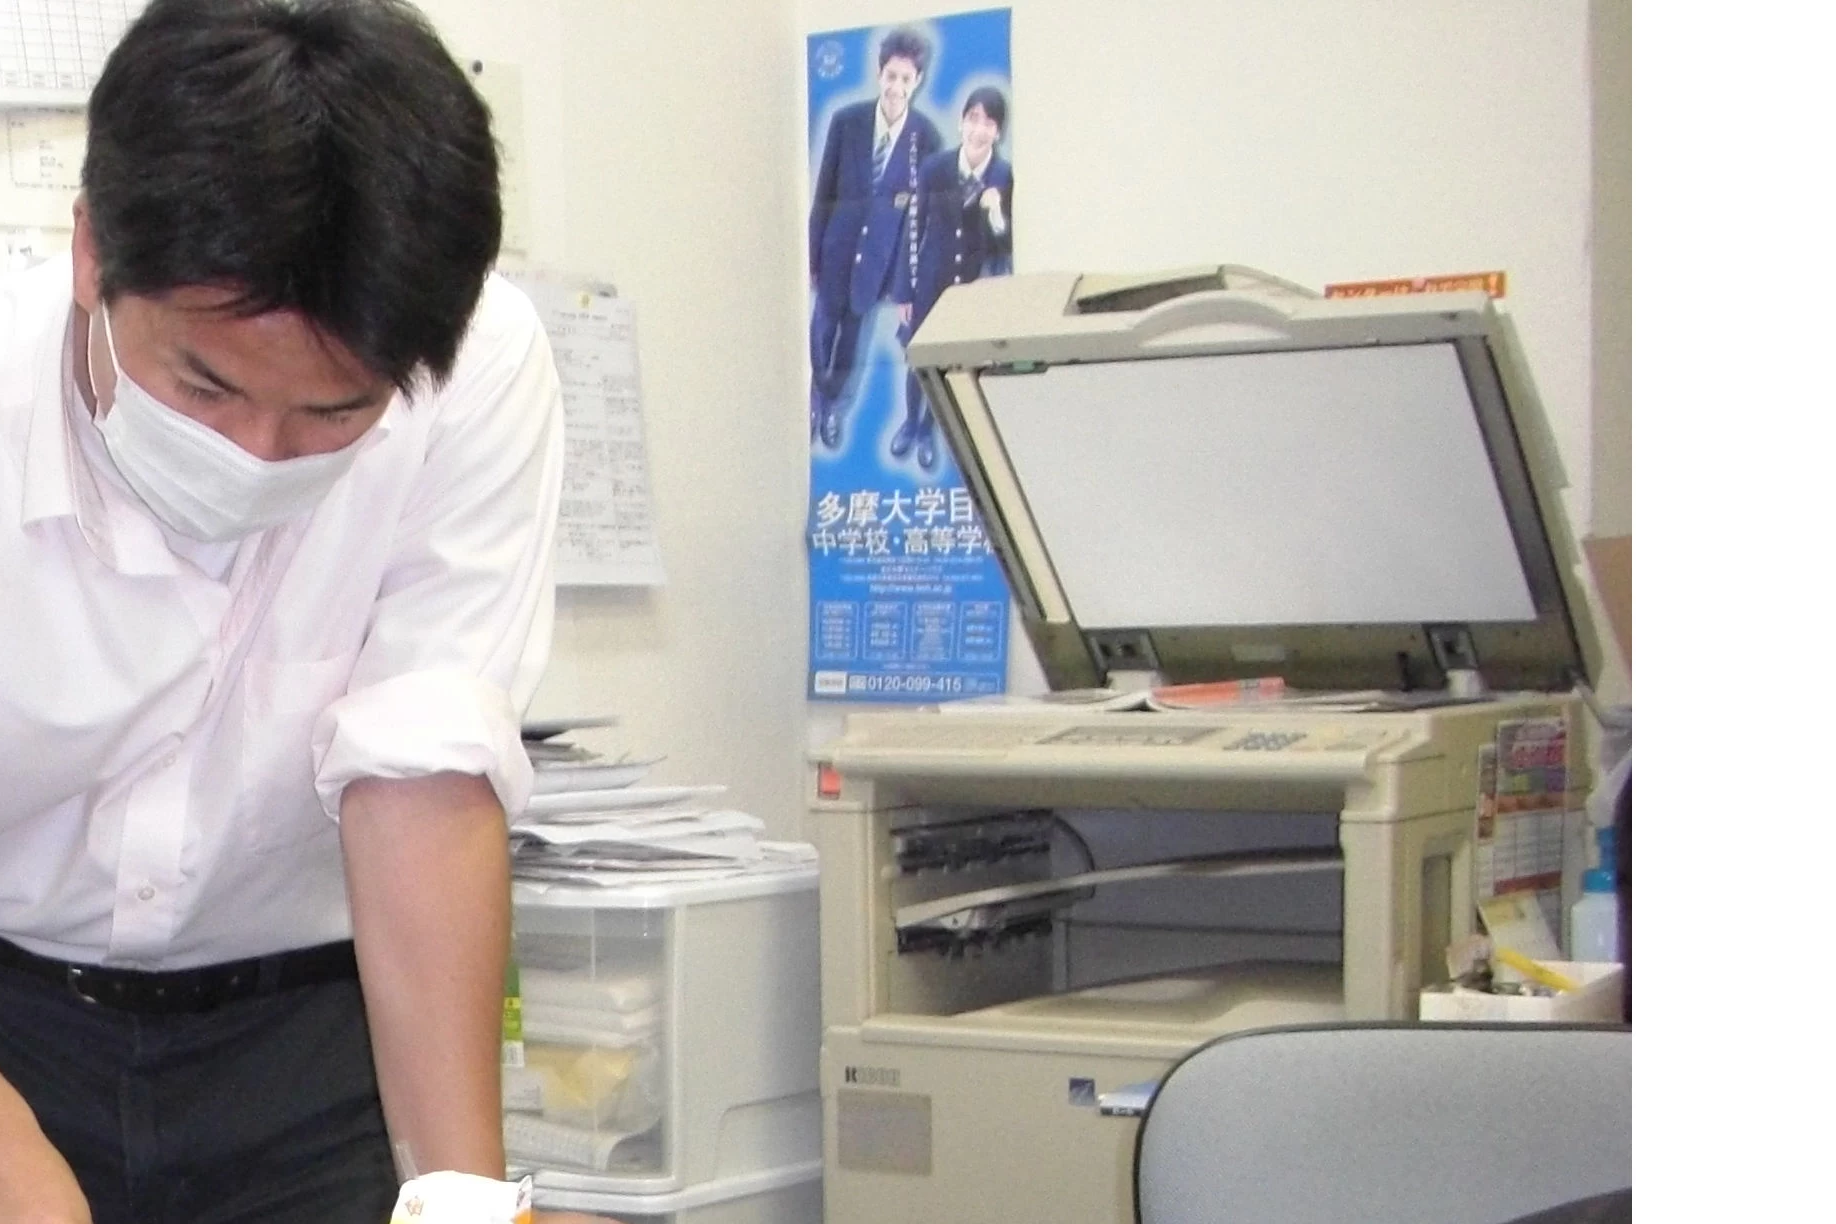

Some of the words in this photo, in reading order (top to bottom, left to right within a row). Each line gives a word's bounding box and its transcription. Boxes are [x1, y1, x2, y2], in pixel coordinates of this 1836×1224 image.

[817, 487, 974, 529] 多摩大学目
[812, 523, 998, 557] 中学校・高等学
